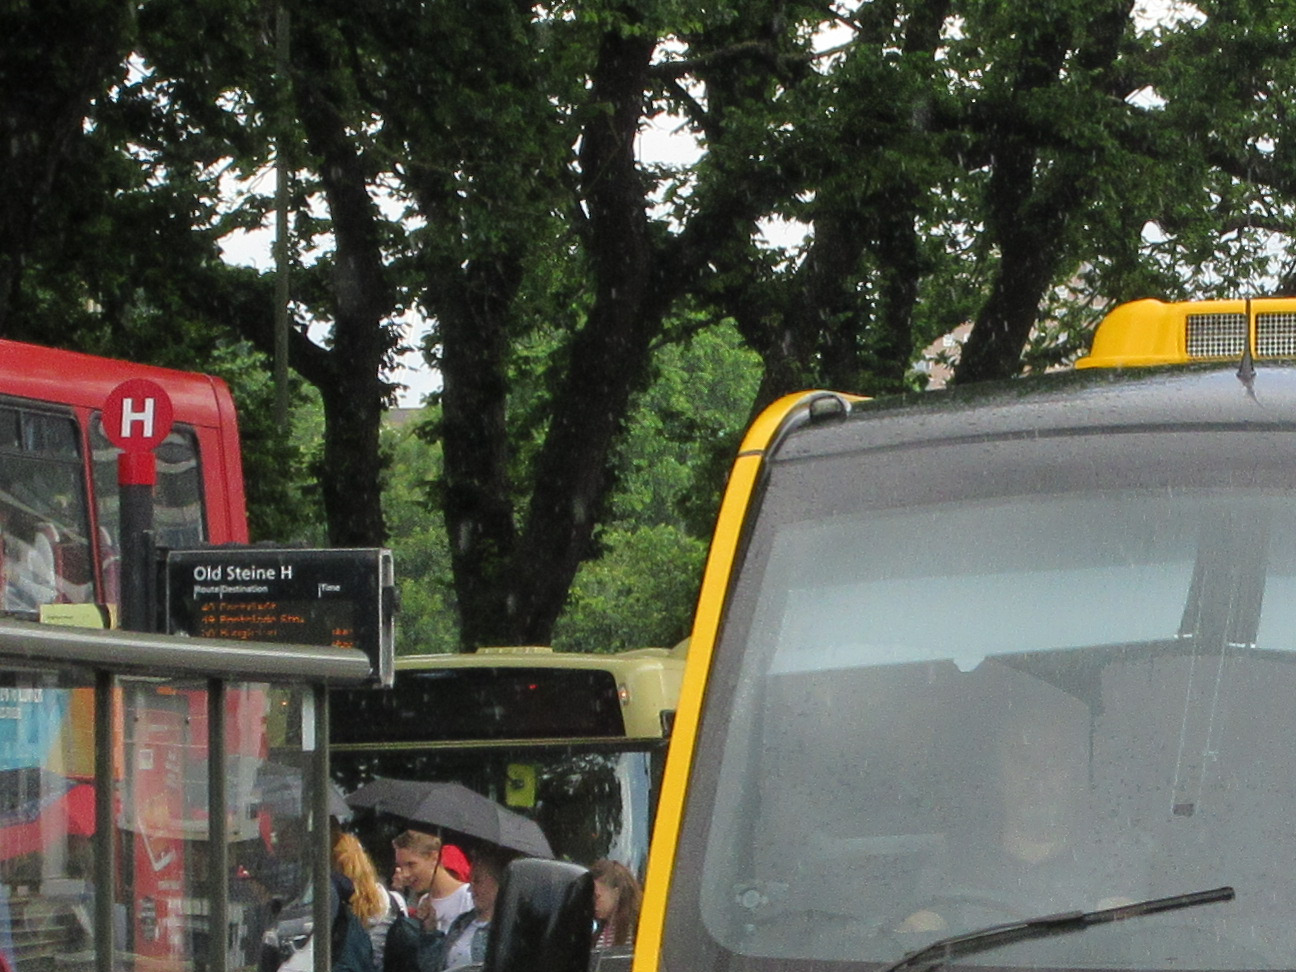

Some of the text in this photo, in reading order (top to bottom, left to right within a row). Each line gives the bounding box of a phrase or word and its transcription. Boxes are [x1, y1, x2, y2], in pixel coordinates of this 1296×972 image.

[120, 398, 154, 438] H
[193, 565, 293, 581] Old Steine H
[195, 583, 341, 594] Route Destination Time
